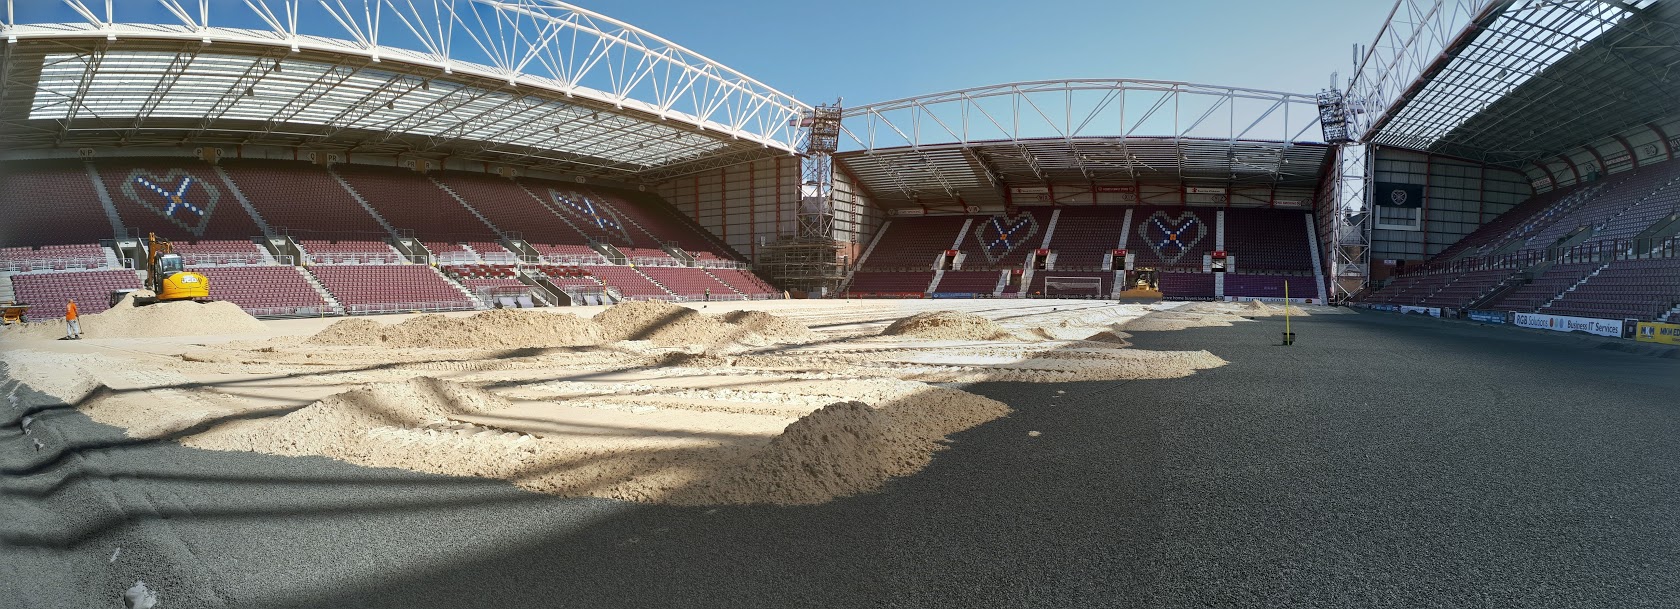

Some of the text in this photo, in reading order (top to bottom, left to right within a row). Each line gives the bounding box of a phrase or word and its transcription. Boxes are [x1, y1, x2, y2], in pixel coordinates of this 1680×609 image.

[1516, 314, 1618, 334] RGB Solutions Business IT Services
